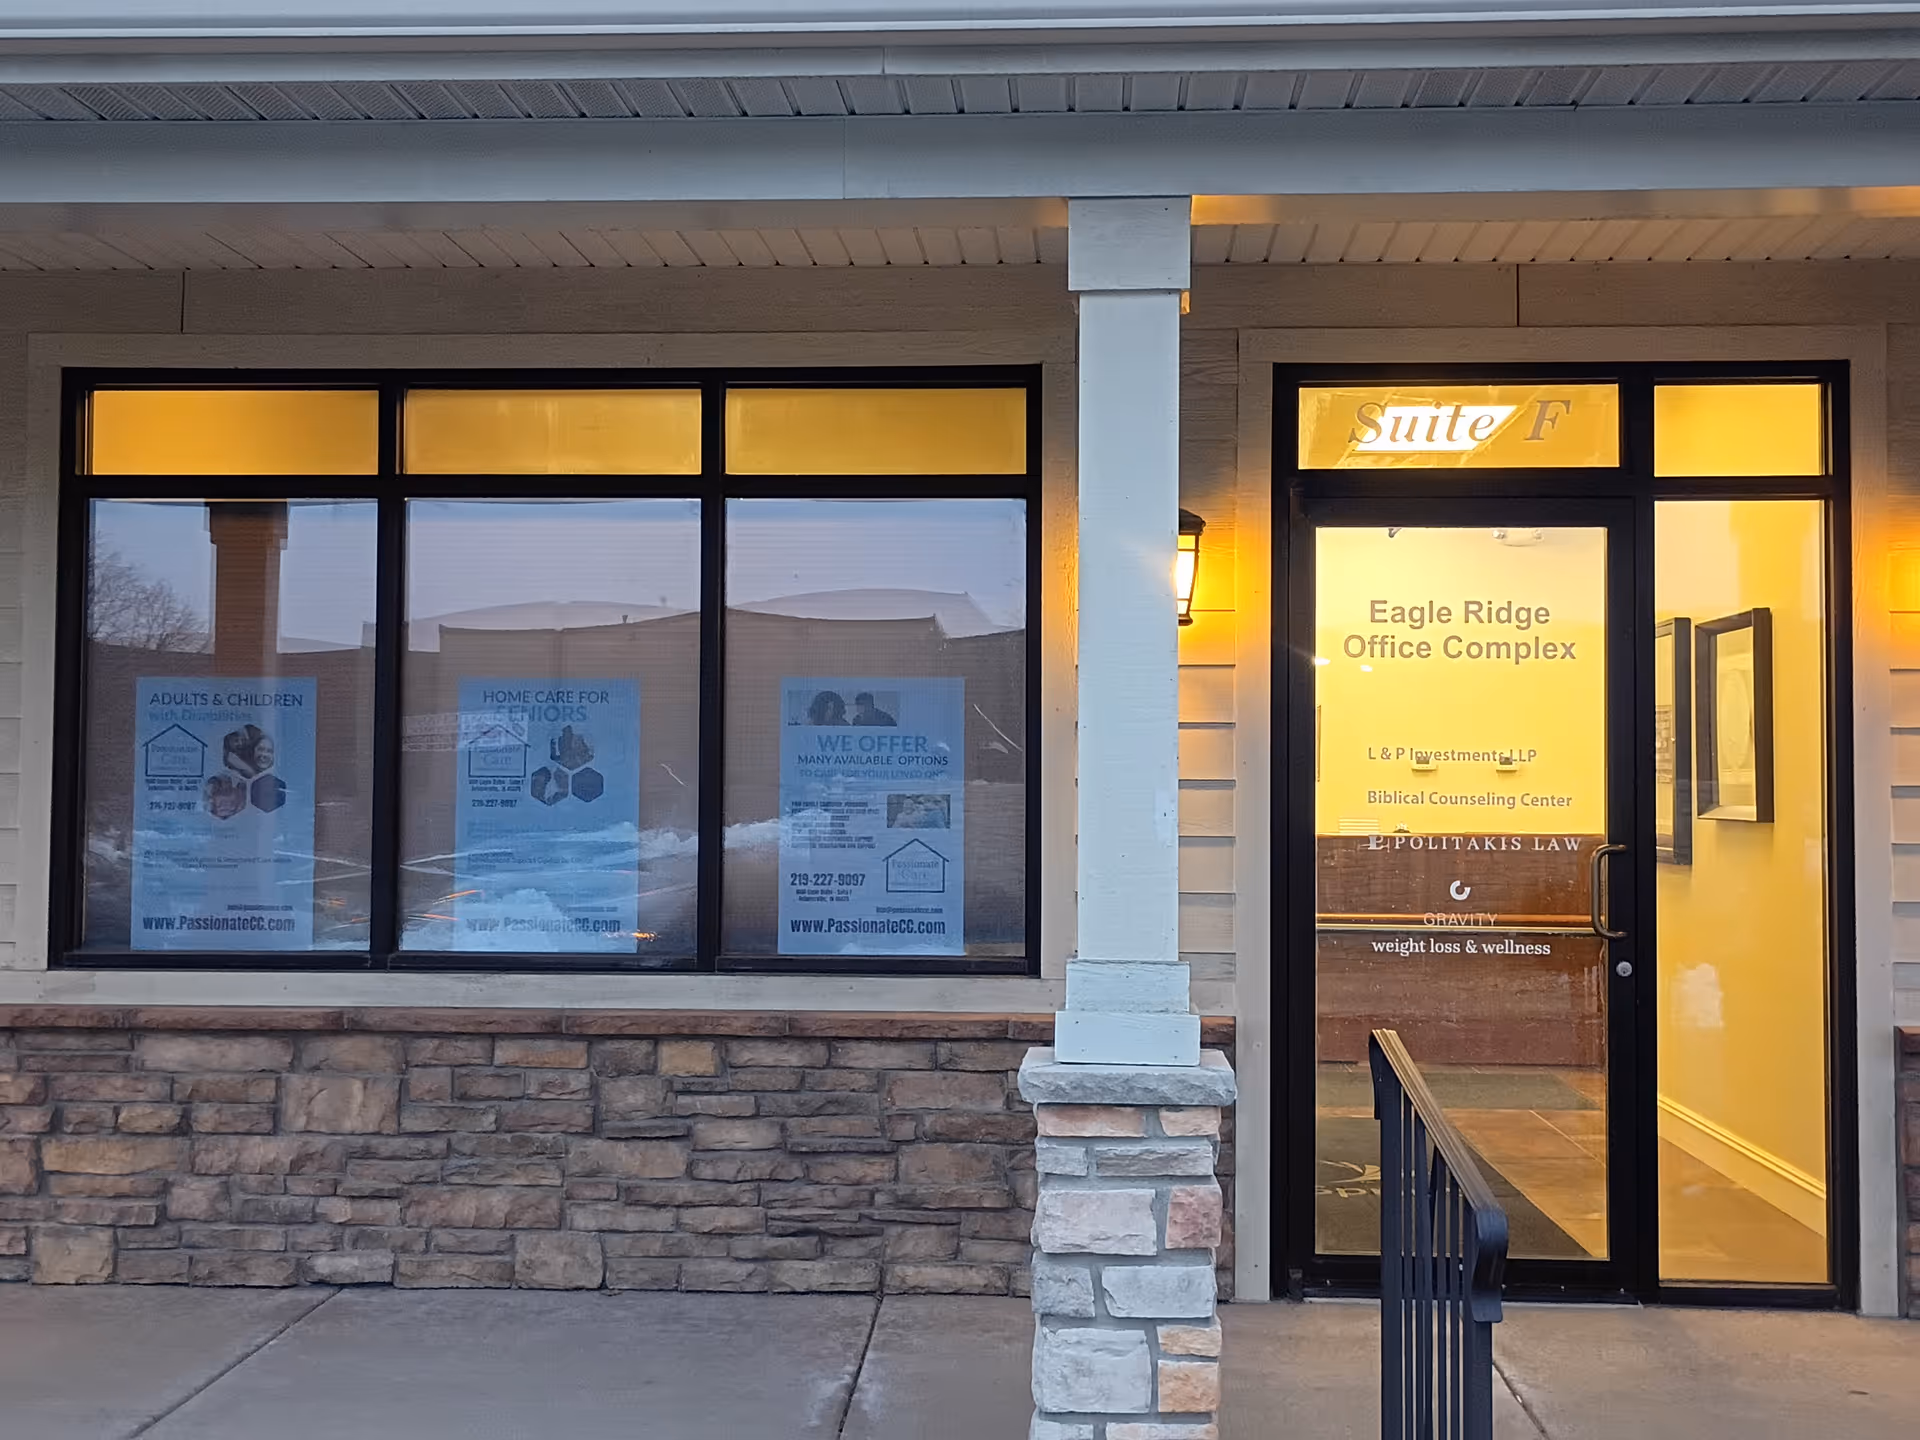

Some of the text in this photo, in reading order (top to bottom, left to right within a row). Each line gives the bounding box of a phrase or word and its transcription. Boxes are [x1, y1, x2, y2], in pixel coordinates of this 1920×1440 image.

[1348, 399, 1571, 444] Suite F
[1369, 599, 1551, 631] Eagle Ridge
[1343, 634, 1577, 665] Office Complex
[149, 692, 304, 708] ADULTS & CHILDREN
[483, 690, 610, 705] HOME CARE FOR
[816, 734, 928, 754] WE OFFER
[797, 754, 949, 766] MANY AVAILABLE OPTIONS
[1368, 747, 1378, 761] L
[1380, 747, 1393, 761] &
[1395, 747, 1405, 761] P
[1510, 748, 1538, 763] LLP
[1367, 790, 1573, 810] Biblical Counseling Center
[1394, 836, 1523, 851] POLITAKIS
[1531, 837, 1582, 852] LAW
[790, 872, 866, 888] 219-227-9097
[142, 914, 296, 933] www.PassionateCC.com
[790, 917, 947, 936] www.PassionateCC.com
[1423, 912, 1498, 927] GRAVITY
[1371, 938, 1552, 956] weight loss & wellness
